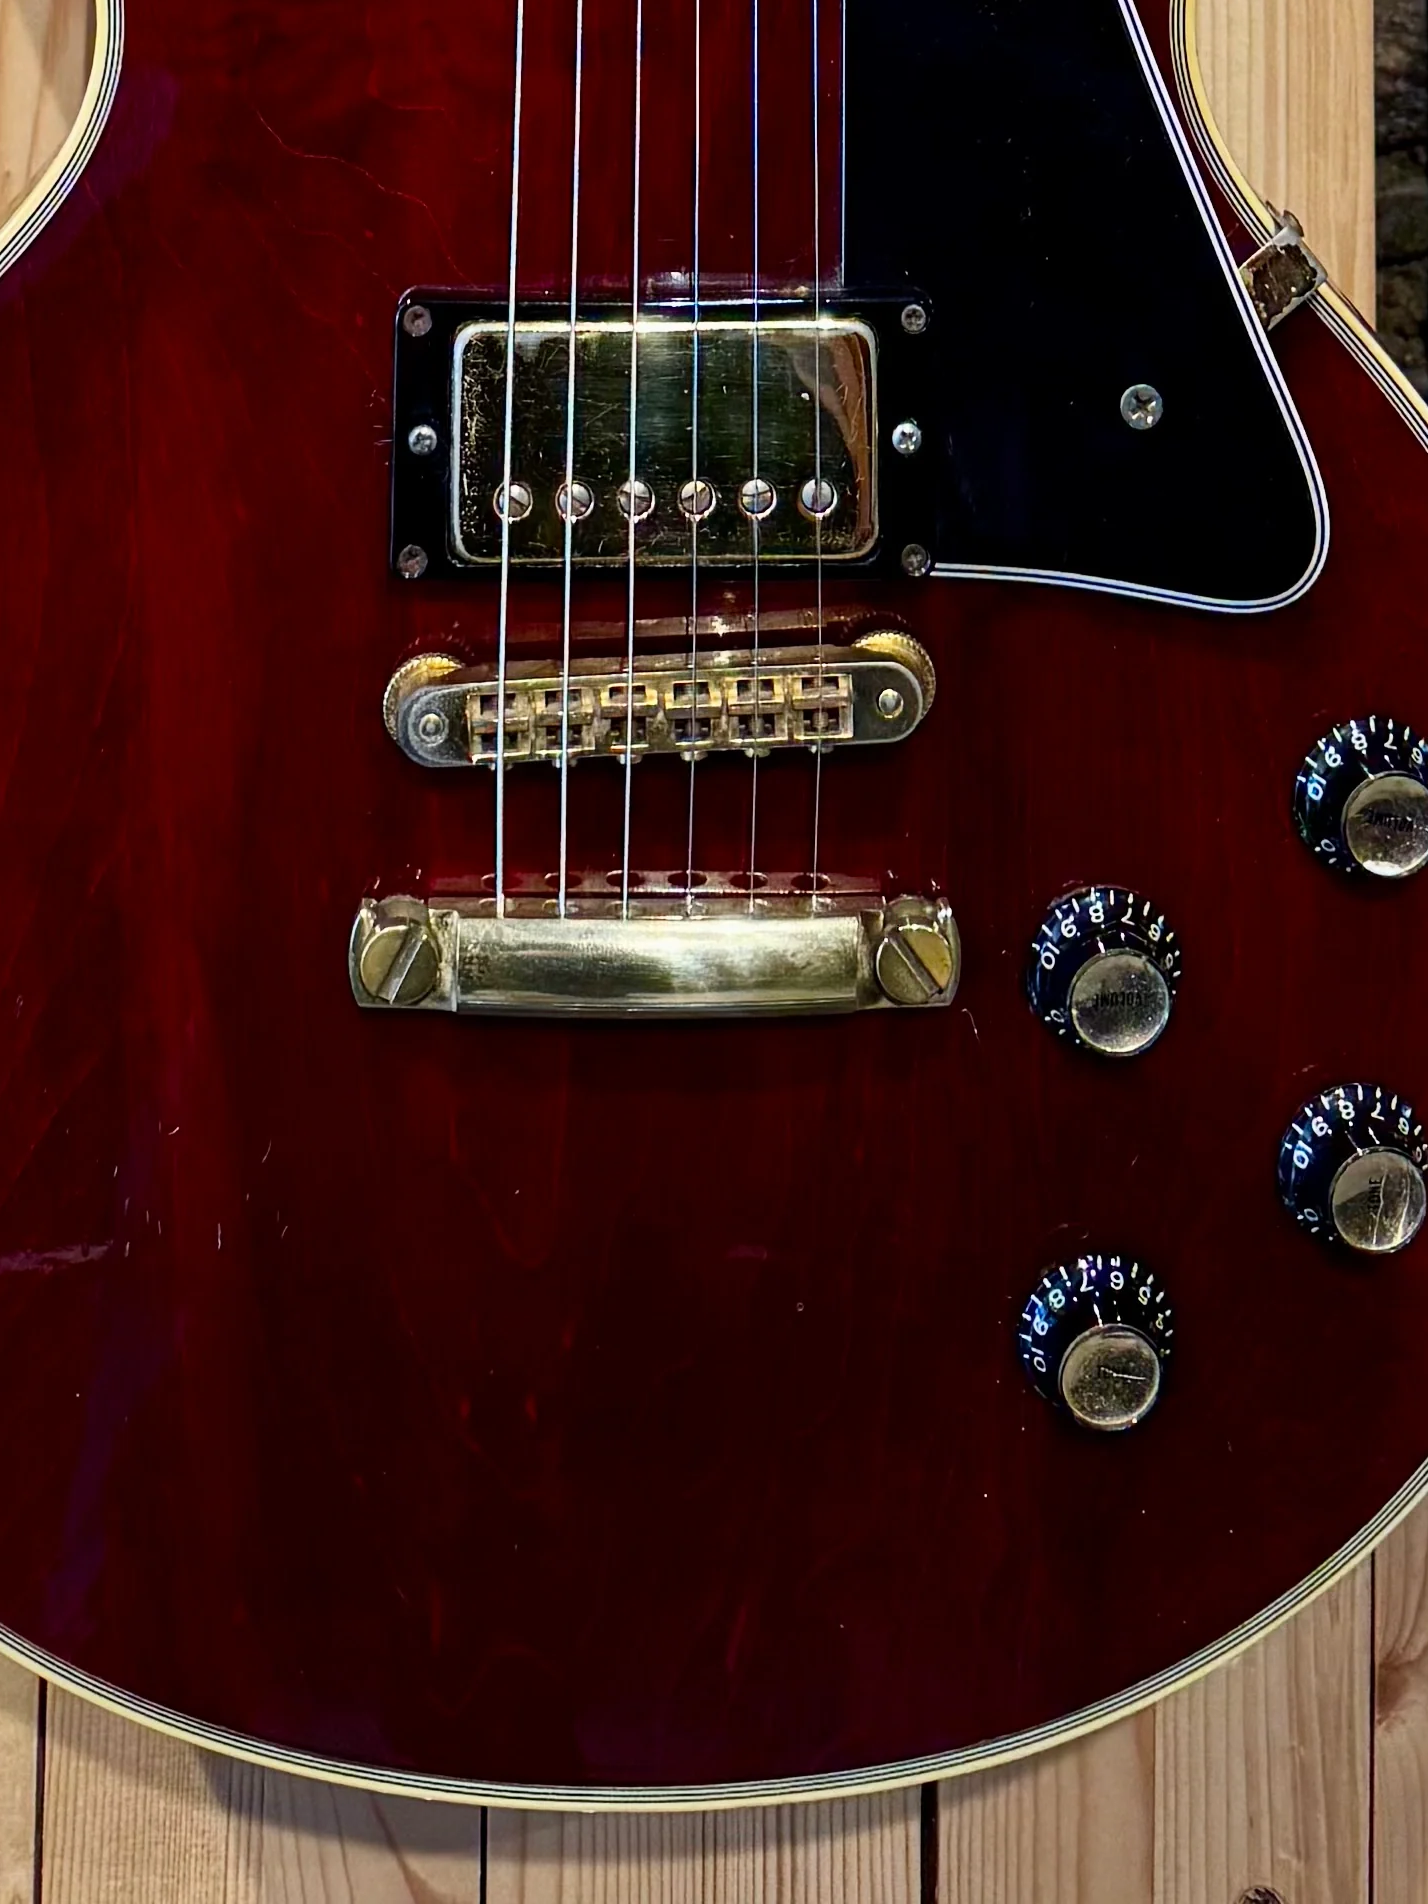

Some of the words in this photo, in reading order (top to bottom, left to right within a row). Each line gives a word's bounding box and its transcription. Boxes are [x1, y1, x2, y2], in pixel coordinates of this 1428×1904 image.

[1352, 733, 1368, 750] 8
[1041, 942, 1060, 970] 10
[1089, 904, 1105, 923] 8
[1339, 1100, 1355, 1120] 8
[1049, 1289, 1066, 1309] 8
